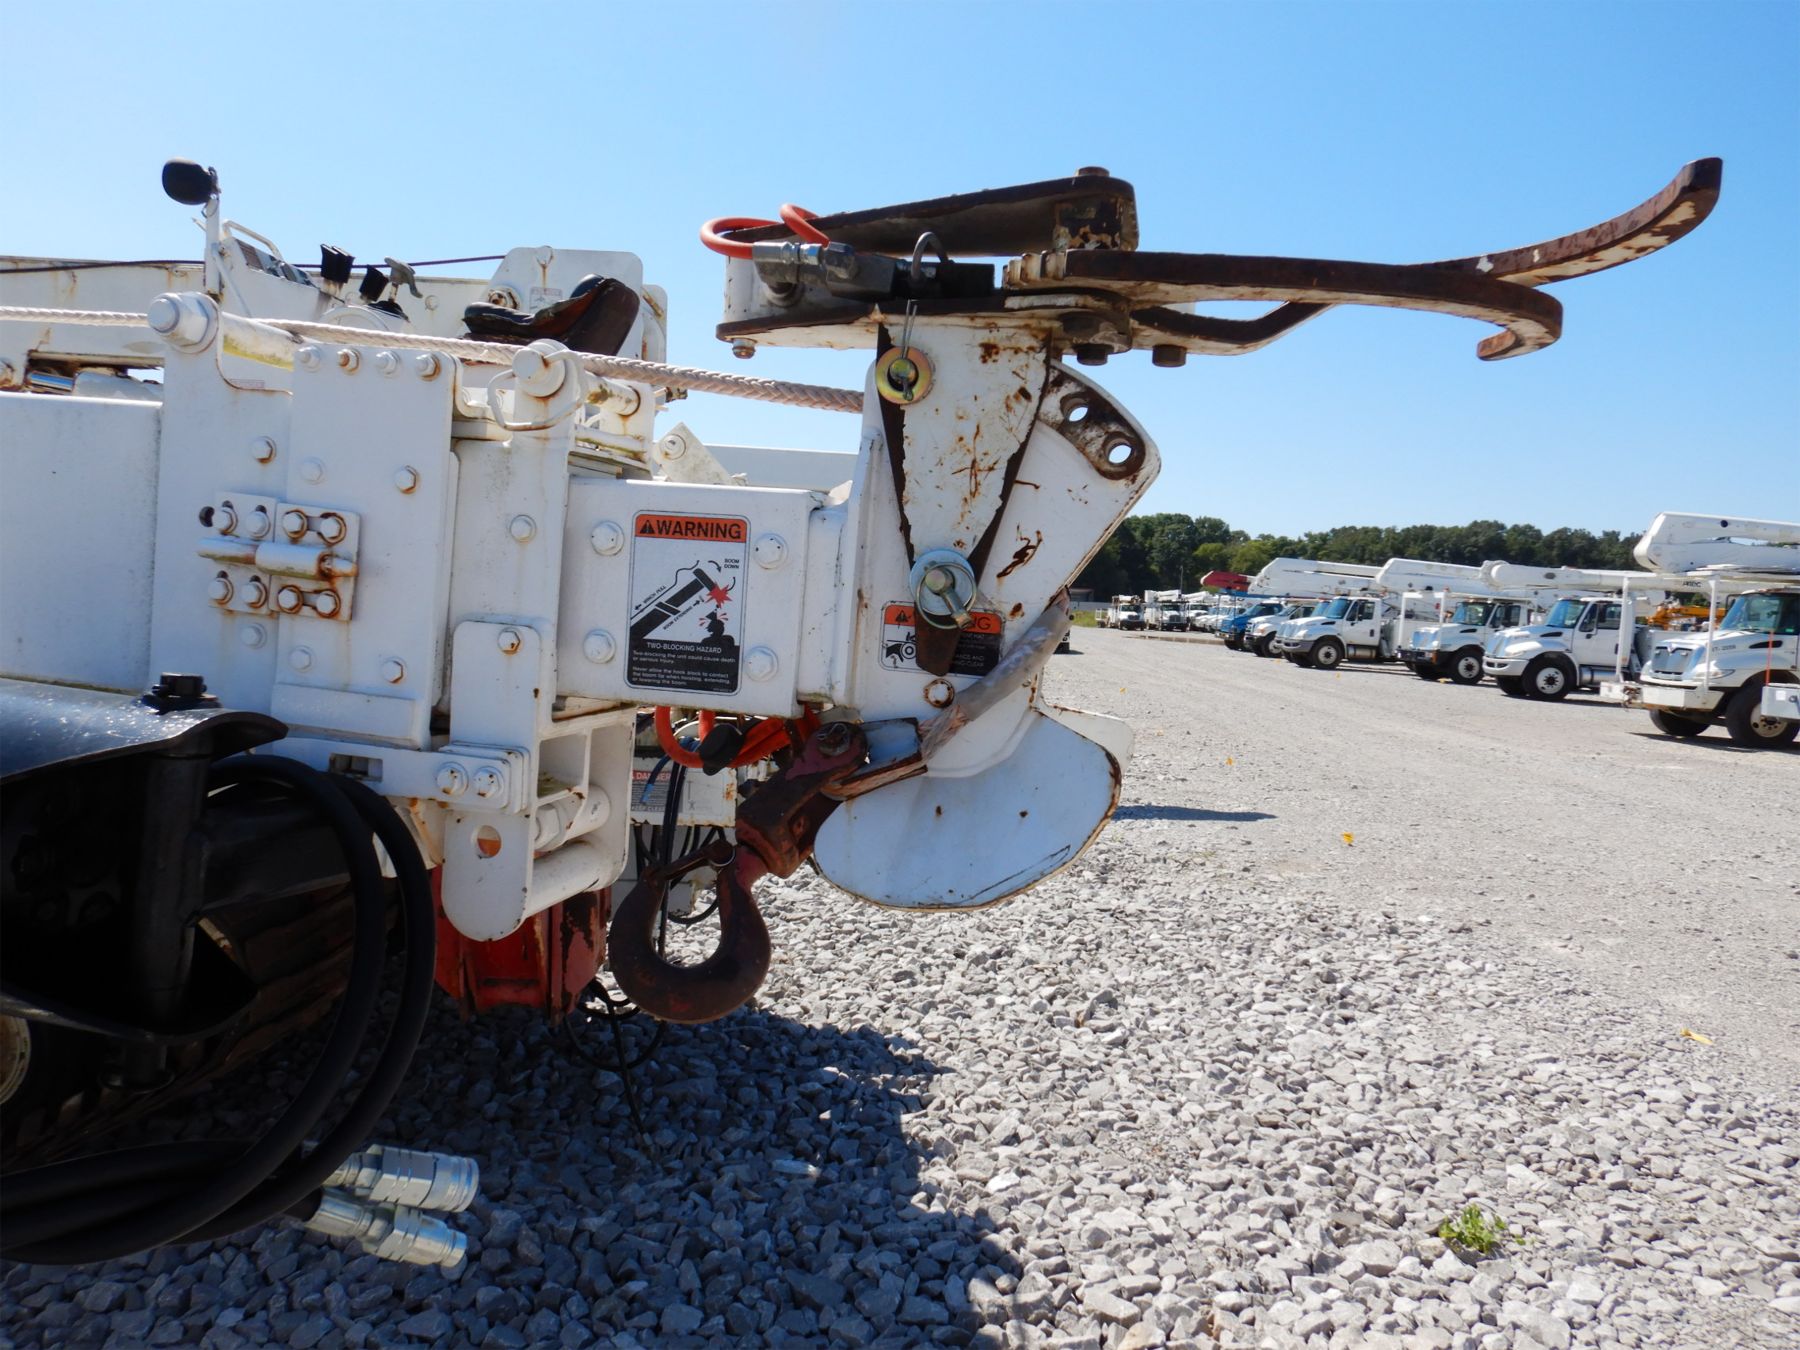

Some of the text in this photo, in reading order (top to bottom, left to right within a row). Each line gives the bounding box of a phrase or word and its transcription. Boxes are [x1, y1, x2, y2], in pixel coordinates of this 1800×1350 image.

[656, 519, 742, 540] WARNING
[647, 642, 722, 654] TWO-BLOCKING HAZARD
